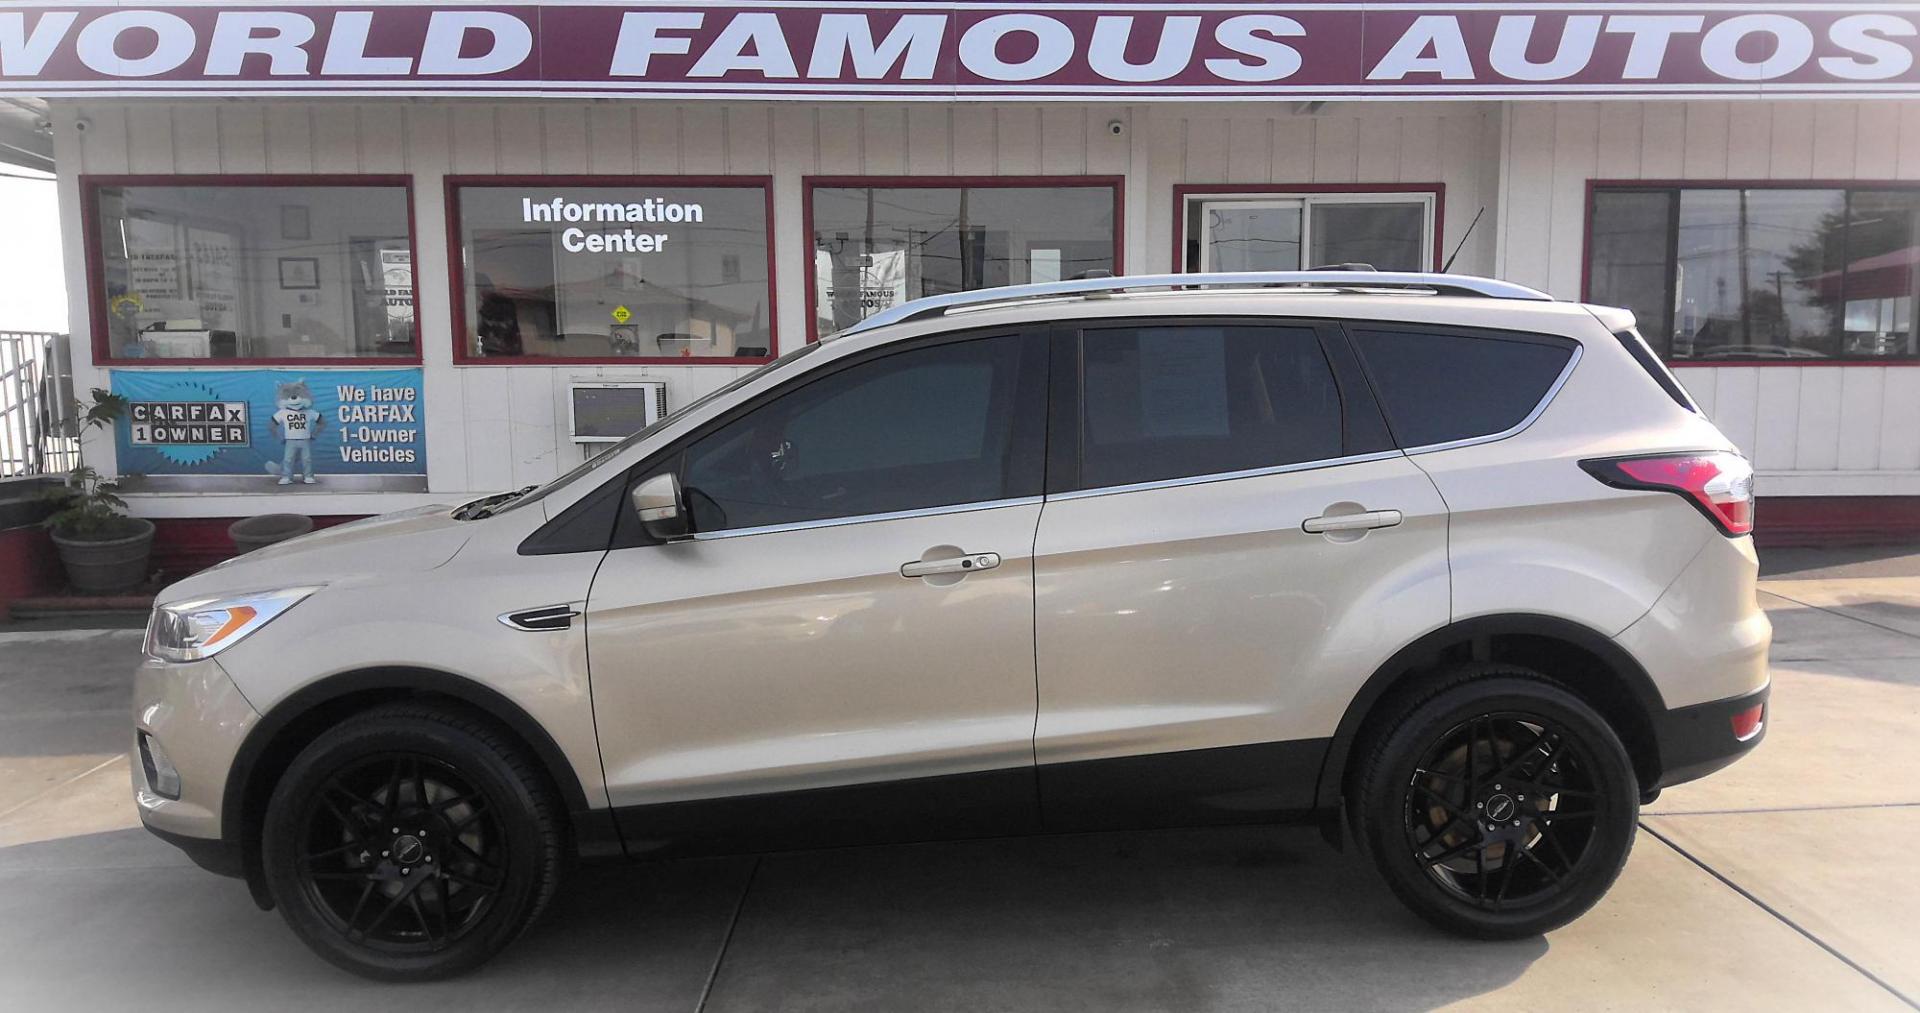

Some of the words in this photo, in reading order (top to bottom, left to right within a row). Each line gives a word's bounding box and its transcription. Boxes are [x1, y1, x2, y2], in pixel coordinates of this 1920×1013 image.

[608, 11, 1307, 83] FAMOUS
[1364, 13, 1919, 82] AUTOS
[522, 197, 703, 224] Information
[561, 228, 669, 253] Center
[337, 385, 365, 402] We
[371, 385, 415, 402] have
[134, 405, 241, 422] CARFAX
[286, 414, 307, 422] CAR
[338, 404, 416, 423] CARFAX
[136, 424, 147, 441] 1
[154, 427, 242, 441] OWNER
[288, 422, 307, 430] FOX
[339, 426, 417, 443] 1-Owner
[340, 445, 416, 463] Vehicles
